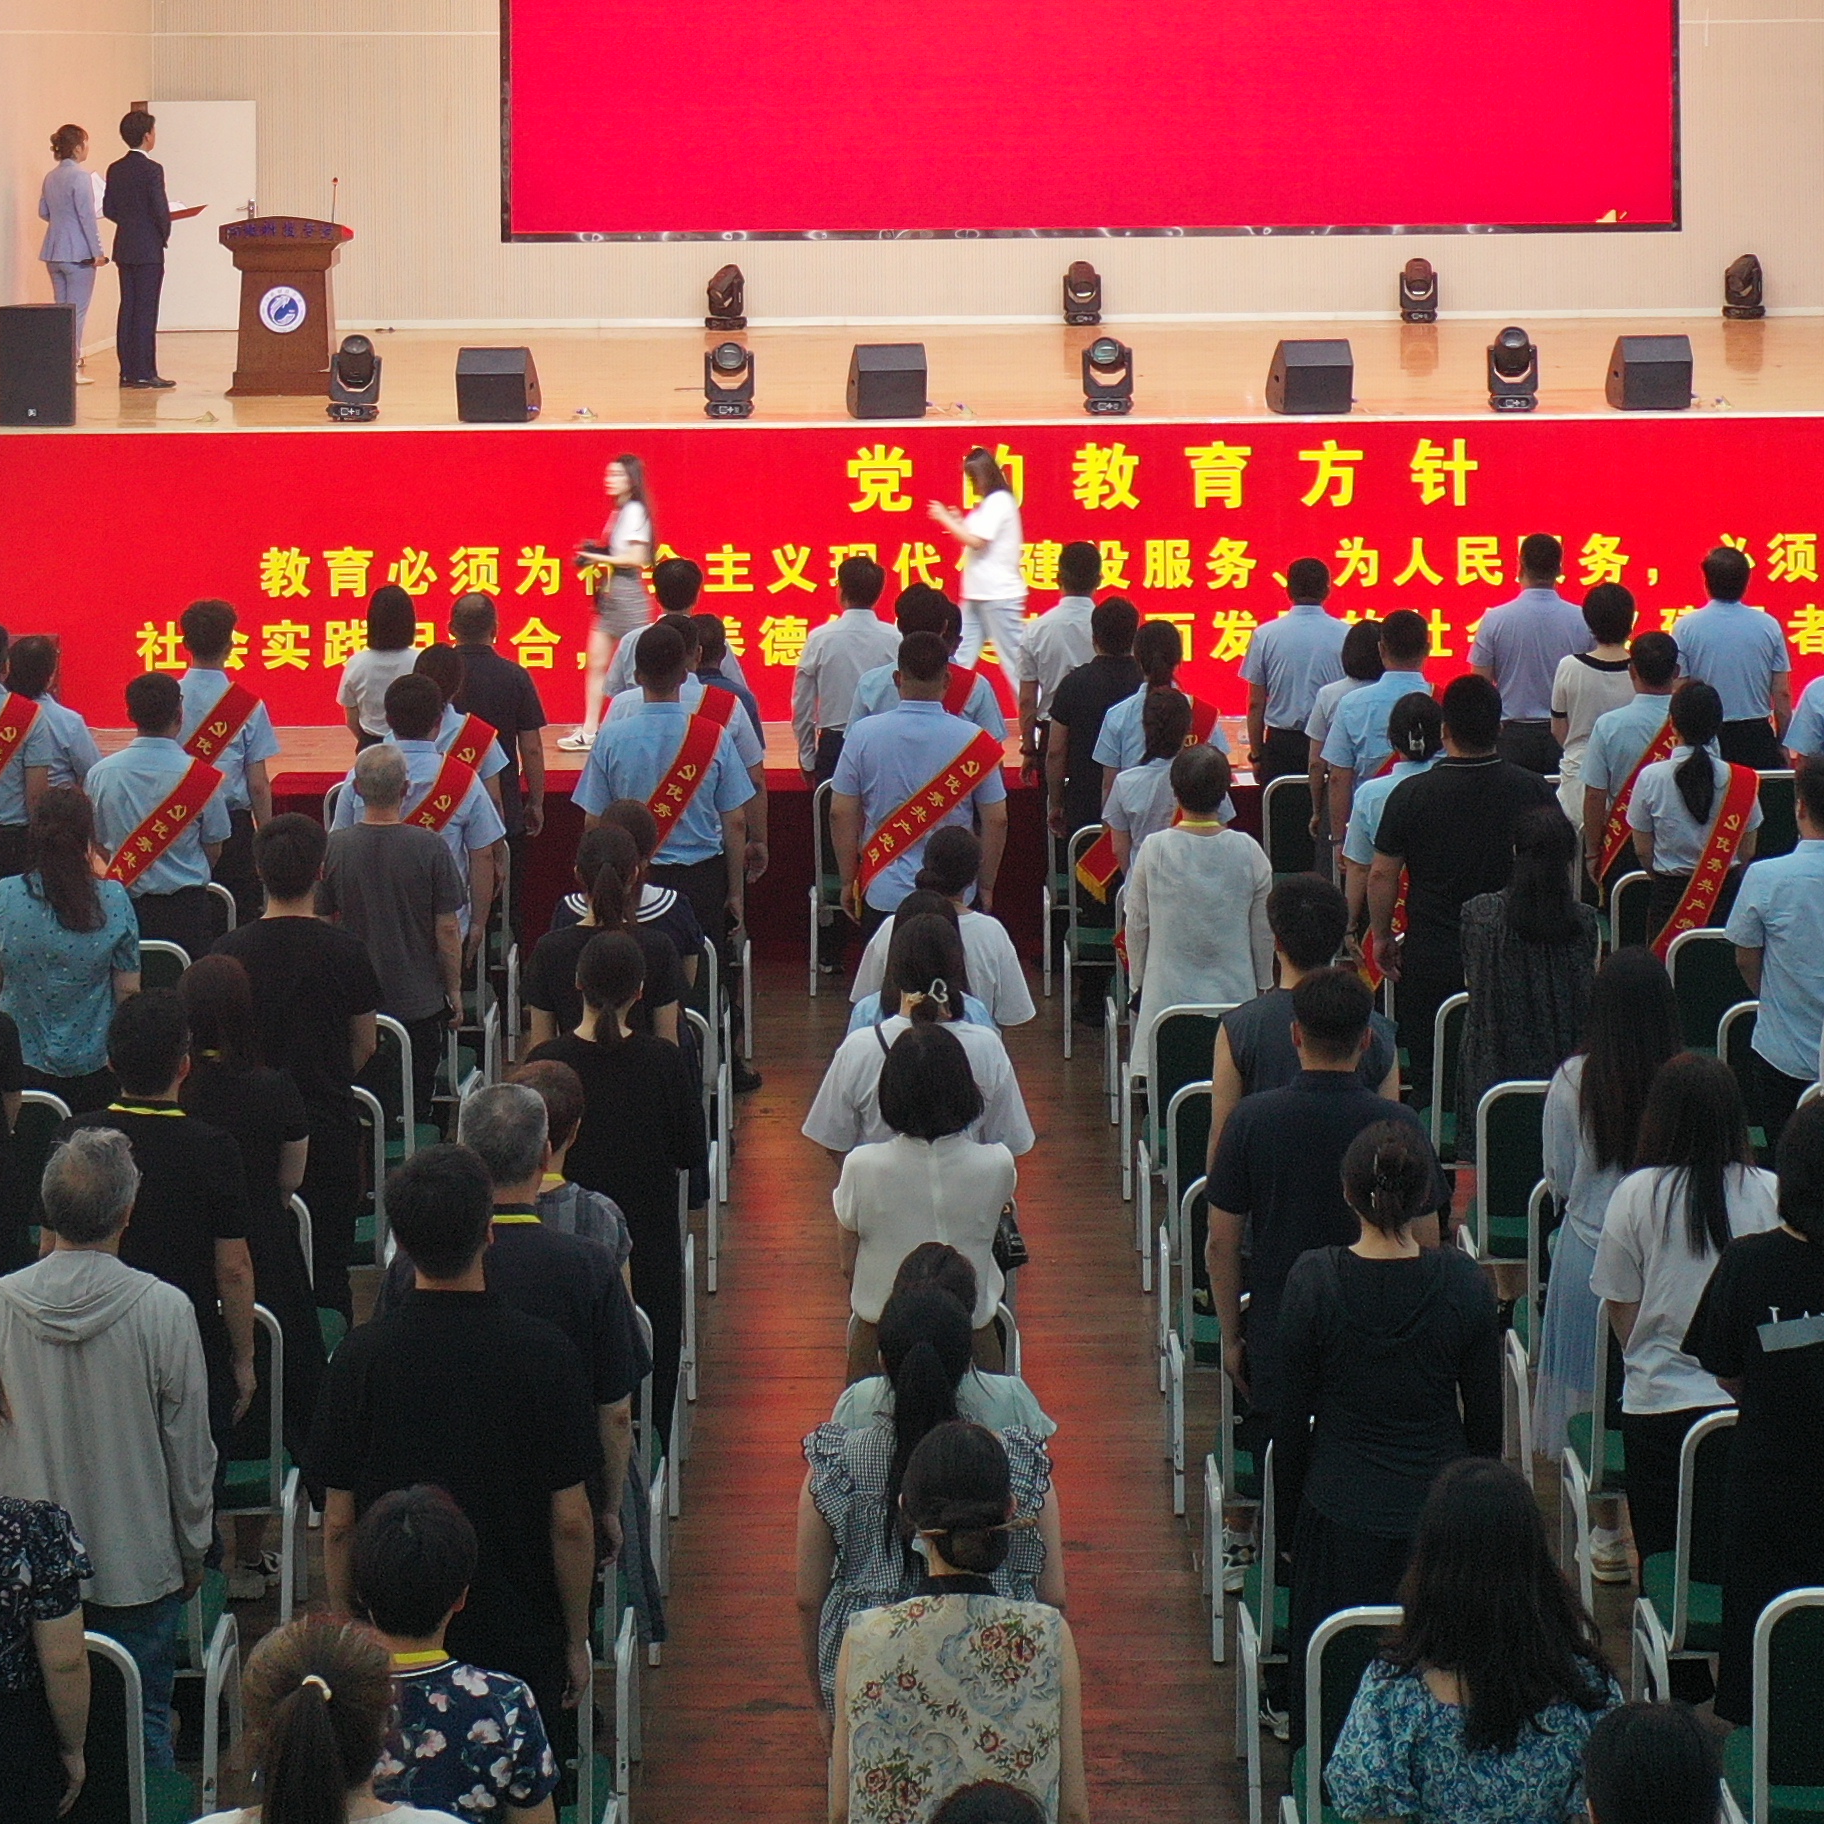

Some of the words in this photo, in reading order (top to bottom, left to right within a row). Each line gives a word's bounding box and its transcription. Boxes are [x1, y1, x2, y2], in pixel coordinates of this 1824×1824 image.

[847, 440, 1479, 513] 党的教育方针
